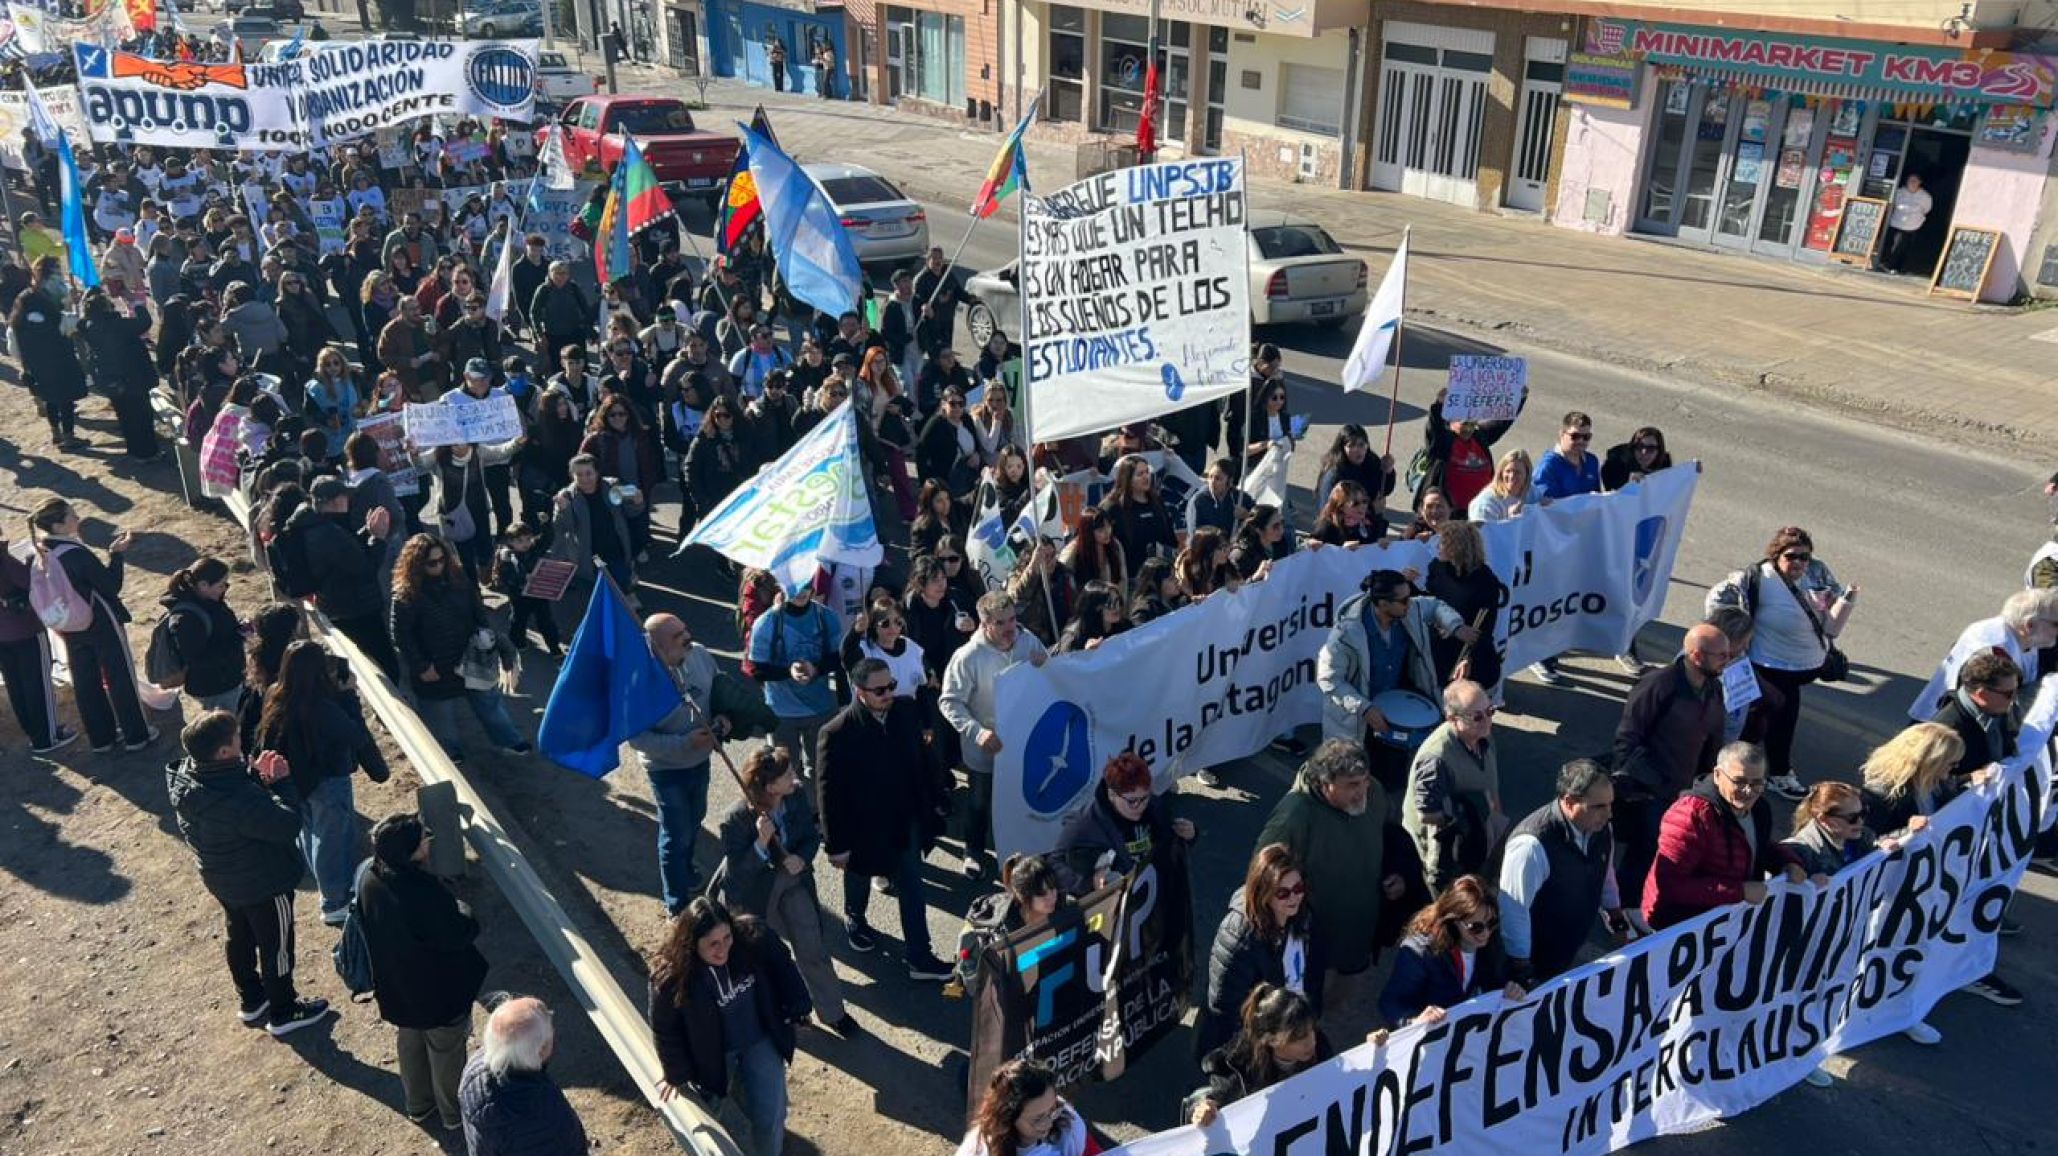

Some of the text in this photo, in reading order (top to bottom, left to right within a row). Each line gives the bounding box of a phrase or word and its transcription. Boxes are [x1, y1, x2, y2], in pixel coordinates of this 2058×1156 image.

[309, 42, 455, 83] SOLIDARIDAD
[1634, 29, 1982, 90] MINIMARKET KM3
[1127, 160, 1235, 205] UNPSJB
[1072, 220, 1108, 253] QUE
[1111, 204, 1145, 243] UN
[1151, 191, 1242, 235] TECHO
[1026, 240, 1199, 298] ES UN HOGAR PARA
[1029, 303, 1061, 339] LOS
[1136, 285, 1169, 322] DE
[1178, 276, 1231, 316] LOS
[1197, 592, 1334, 685] Unversid
[1166, 718, 1193, 757] la
[1508, 592, 1606, 638] Bosco
[1123, 992, 1145, 1020] DE
[1147, 977, 1172, 1005] LA
[1368, 951, 1653, 1156] DEFENSA
